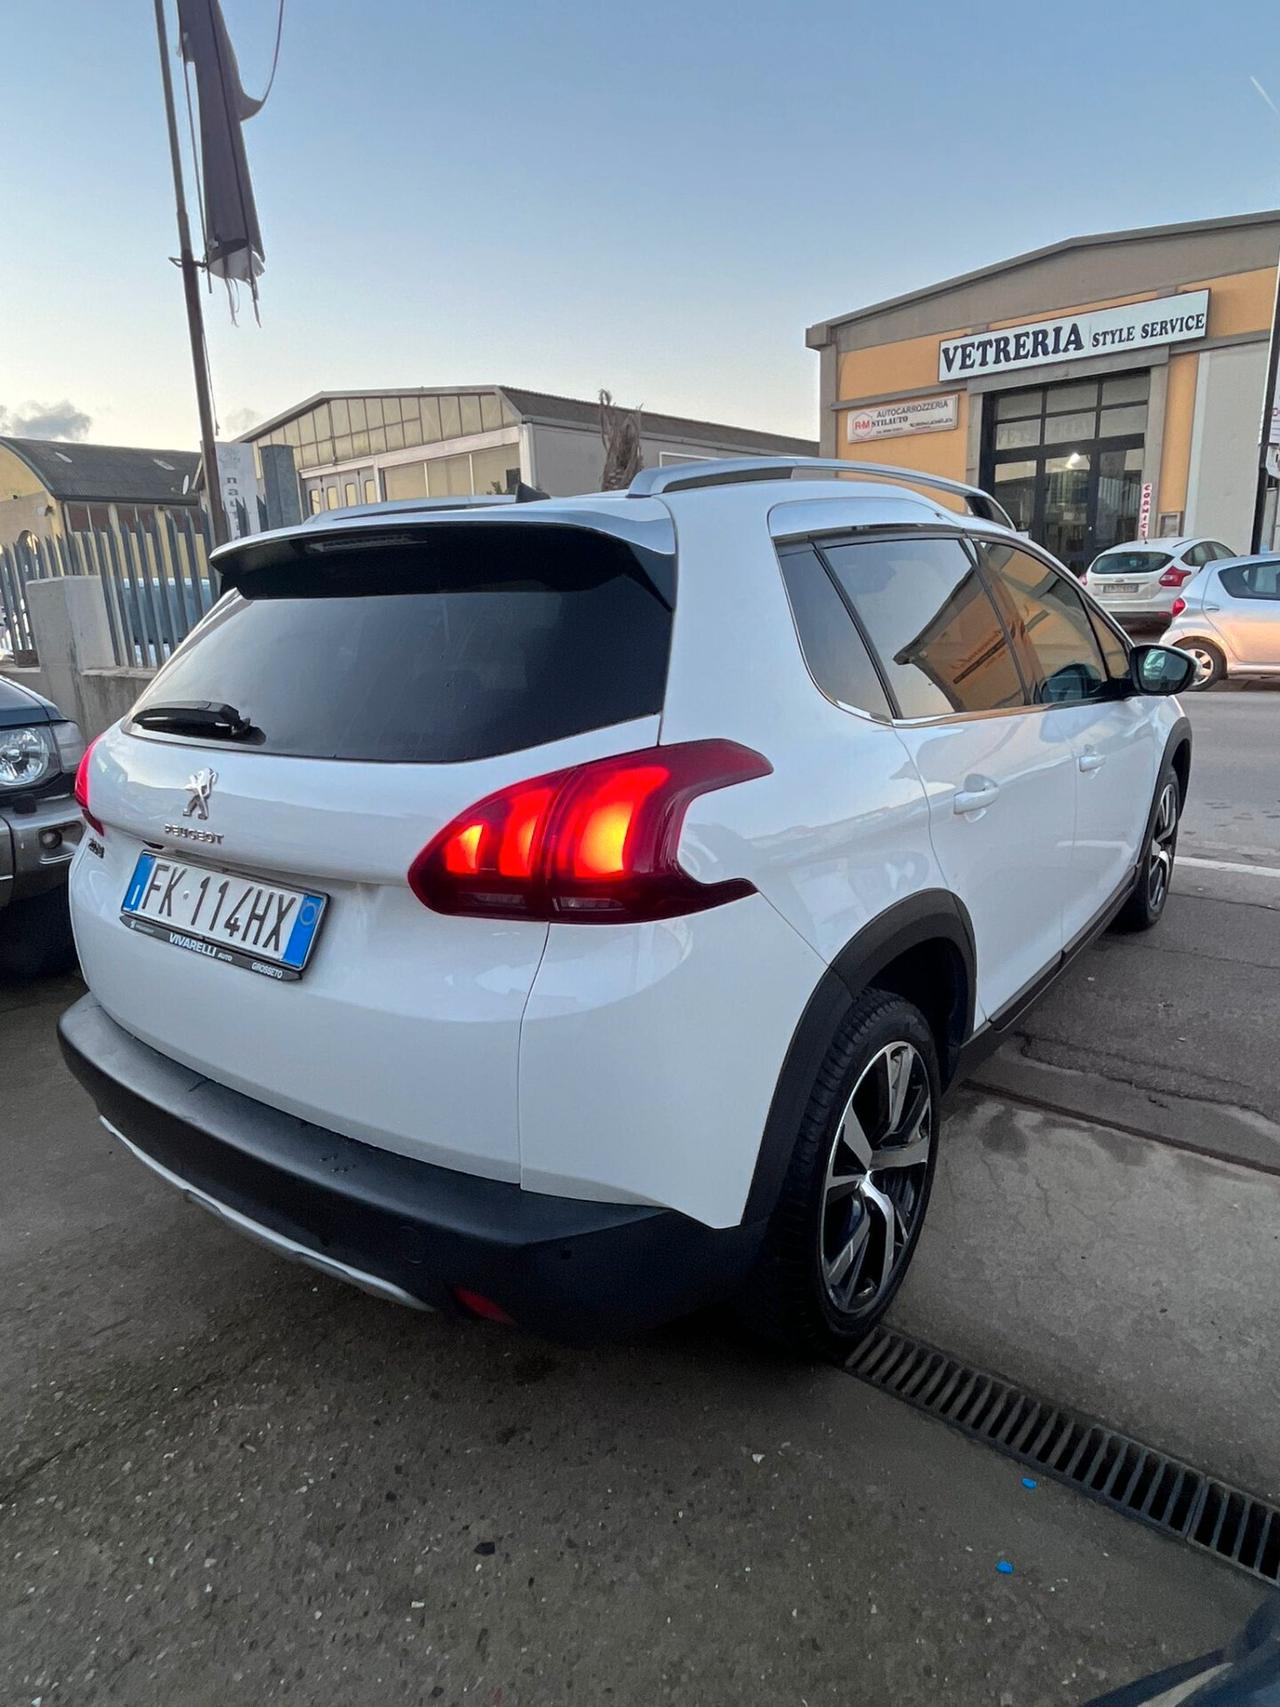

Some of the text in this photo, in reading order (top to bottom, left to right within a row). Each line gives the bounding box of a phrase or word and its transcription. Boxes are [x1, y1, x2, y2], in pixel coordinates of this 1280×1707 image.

[942, 313, 1205, 373] VETRERIA STYLE SERVICE
[876, 400, 949, 418] AUTOCARROZZERIA
[872, 415, 909, 427] STILAUTO
[164, 823, 224, 844] PEUGEOT
[169, 932, 217, 957] VIVARELLI
[251, 962, 283, 978] GROSSETO
